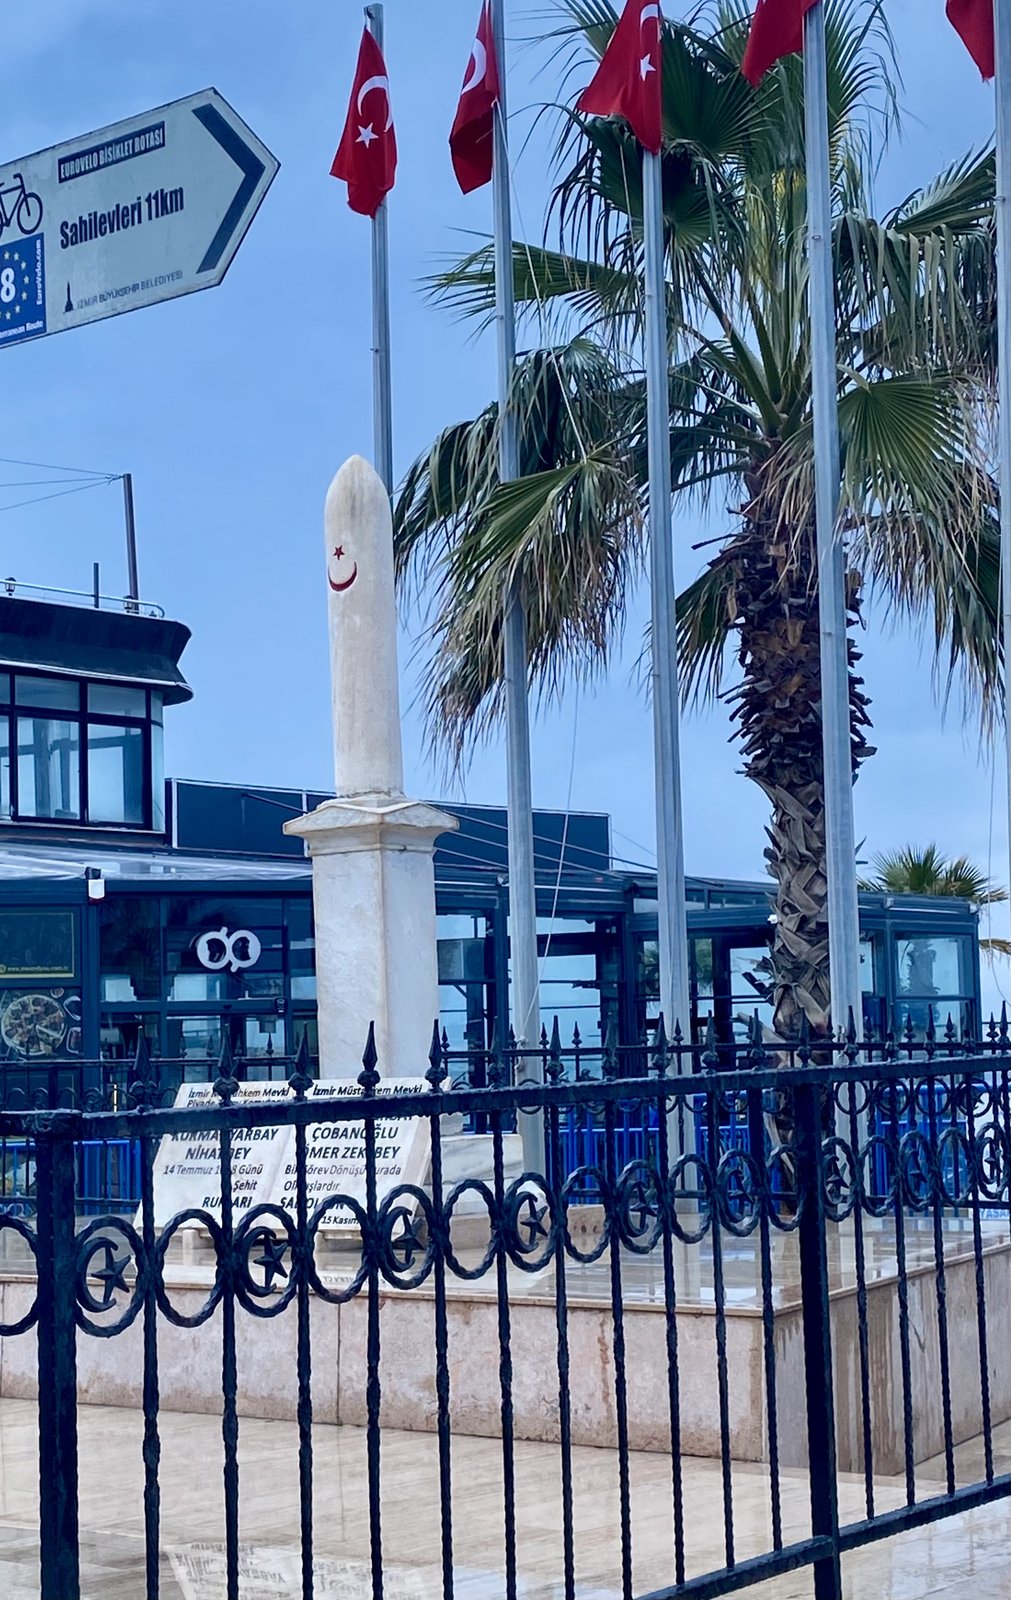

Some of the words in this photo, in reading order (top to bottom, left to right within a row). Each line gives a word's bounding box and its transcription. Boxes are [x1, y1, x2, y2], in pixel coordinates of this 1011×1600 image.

[60, 151, 98, 179] EUROVELO
[134, 128, 163, 153] ROTASI
[60, 196, 142, 250] Sahilevleri
[145, 186, 185, 221] 11km
[1, 267, 16, 303] 8
[163, 1164, 175, 1175] 14
[177, 1164, 214, 1175] Temmuz
[239, 1163, 264, 1175] Günü
[233, 1180, 258, 1193] Şehit
[321, 1215, 332, 1225] 15
